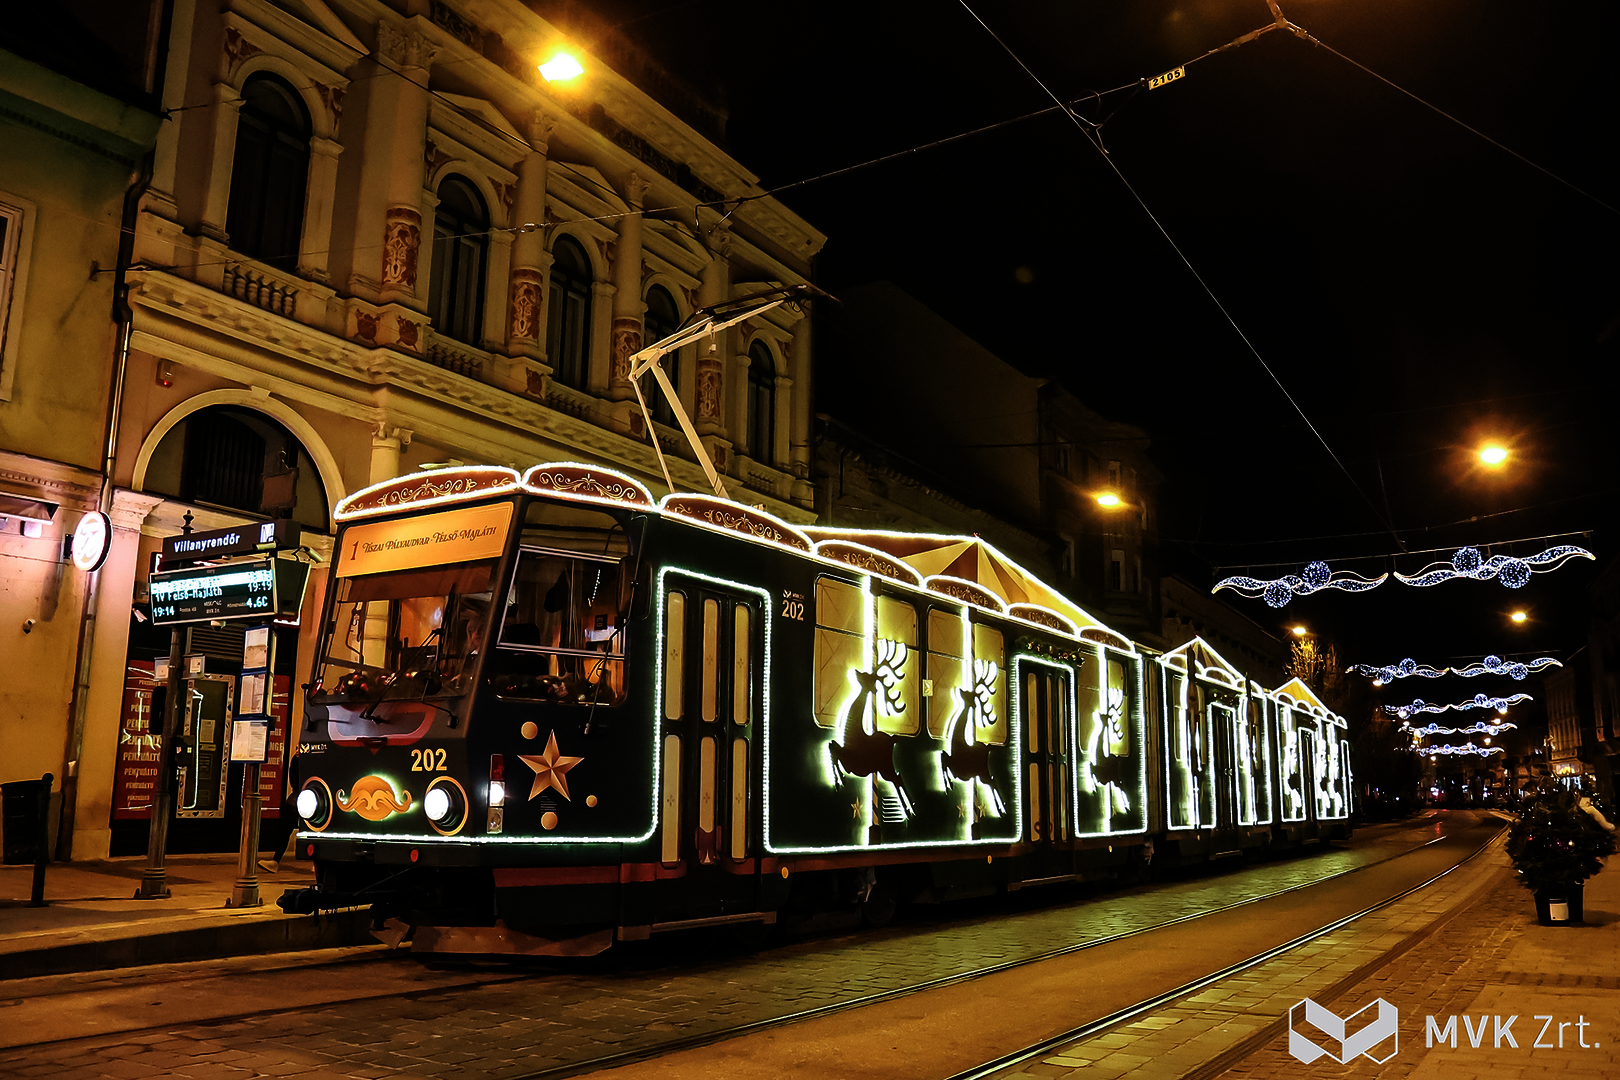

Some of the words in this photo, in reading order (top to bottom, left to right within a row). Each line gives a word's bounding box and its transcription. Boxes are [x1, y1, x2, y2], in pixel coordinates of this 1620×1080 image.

[1153, 69, 1180, 86] 2105
[174, 532, 240, 553] Villanyrendőr
[350, 541, 359, 560] 1
[153, 606, 175, 617] 19:14
[782, 599, 804, 621] 202
[411, 748, 447, 772] 202
